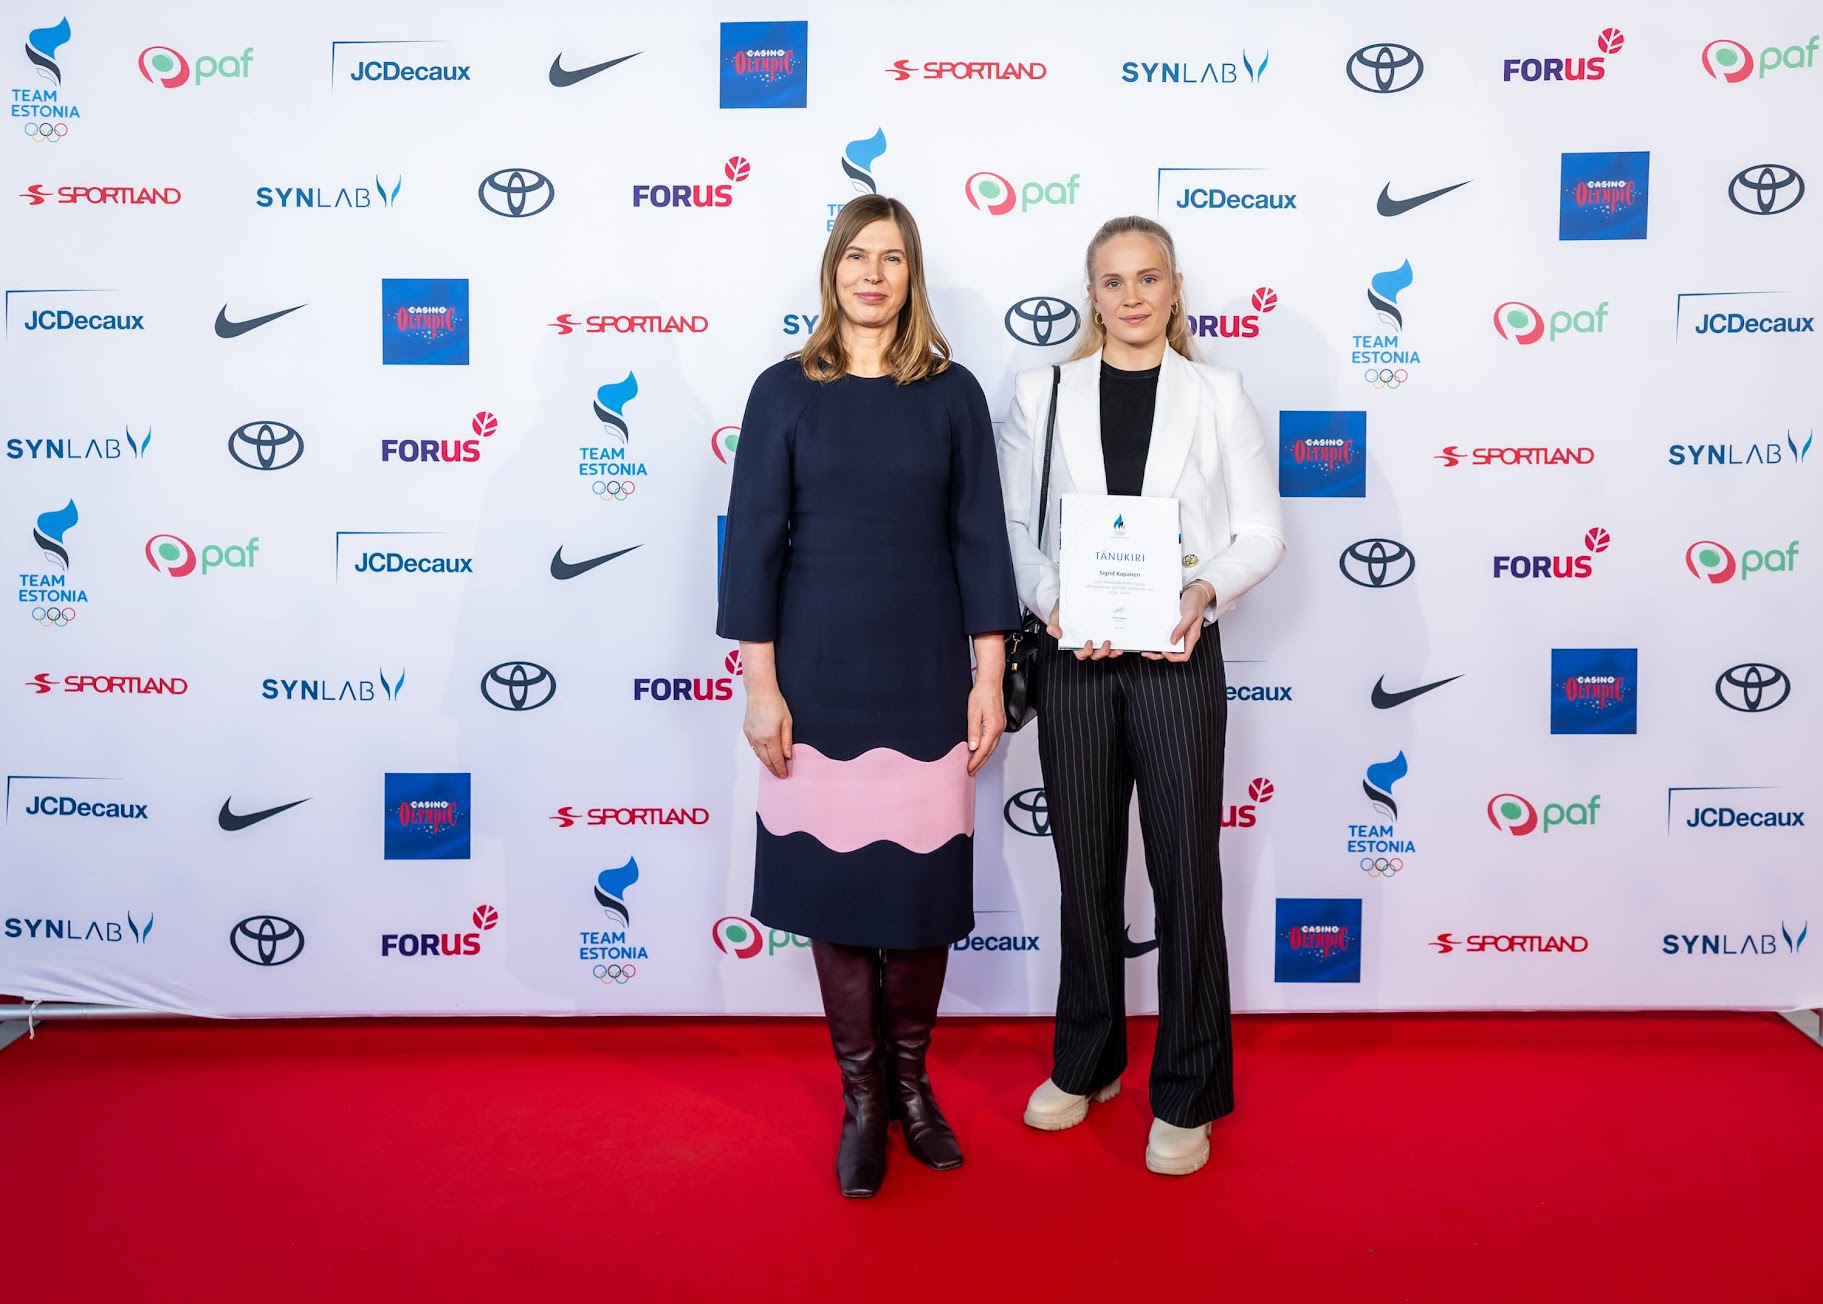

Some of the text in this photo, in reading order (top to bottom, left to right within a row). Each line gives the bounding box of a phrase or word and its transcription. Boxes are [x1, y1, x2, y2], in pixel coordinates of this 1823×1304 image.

[195, 47, 254, 86] paf
[1759, 35, 1820, 79] paf
[351, 61, 470, 81] JCDecaux
[924, 62, 1047, 79] SPORTLAND
[1122, 62, 1236, 83] SYNLAB
[1504, 57, 1605, 81] FORUS
[12, 89, 57, 102] TEAM
[12, 104, 80, 118] ESTONIA
[58, 187, 181, 204] SPORTLAND
[256, 187, 370, 207] SYNLAB
[633, 185, 732, 207] FORUS
[1022, 174, 1080, 213] paf
[1177, 189, 1297, 209] JCDecaux
[25, 310, 144, 330] JCDecaux
[586, 316, 708, 333] SPORTLAND
[1550, 301, 1608, 342] paf
[1695, 314, 1814, 334] JCDecaux
[1353, 336, 1398, 348] TEAM
[1352, 351, 1420, 364] ESTONIA
[7, 439, 120, 459] SYNLAB
[382, 440, 480, 462] FORUS
[580, 448, 624, 460] TEAM
[1472, 448, 1594, 465] SPORTLAND
[1669, 444, 1781, 465] SYNLAB
[580, 463, 647, 475] ESTONIA
[202, 537, 259, 575] paf
[355, 553, 473, 573] JCDecaux
[1096, 551, 1144, 562] TÄNUKIRI
[1742, 540, 1799, 581] paf
[1494, 555, 1593, 578] FORUS
[20, 574, 65, 587] TEAM
[19, 590, 88, 602] ESTONIA
[65, 676, 187, 694] SPORTLAND
[262, 679, 374, 700] SYNLAB
[634, 678, 733, 701] FORUS
[1227, 686, 1292, 702] ecaux
[26, 796, 148, 819] JCDecaux
[587, 808, 709, 825] SPORTLAND
[1543, 795, 1600, 833] paf
[1687, 808, 1804, 827] JCDecaux
[1348, 825, 1393, 837] TEAM
[1348, 840, 1415, 853] ESTONIA
[5, 918, 122, 942] SYNLAB
[580, 932, 625, 944] TEAM
[382, 933, 480, 956] FORUS
[949, 932, 1039, 952] Decaux
[1467, 935, 1588, 952] SPORTLAND
[1663, 934, 1776, 954] SYNLAB
[580, 947, 648, 960] ESTONIA
